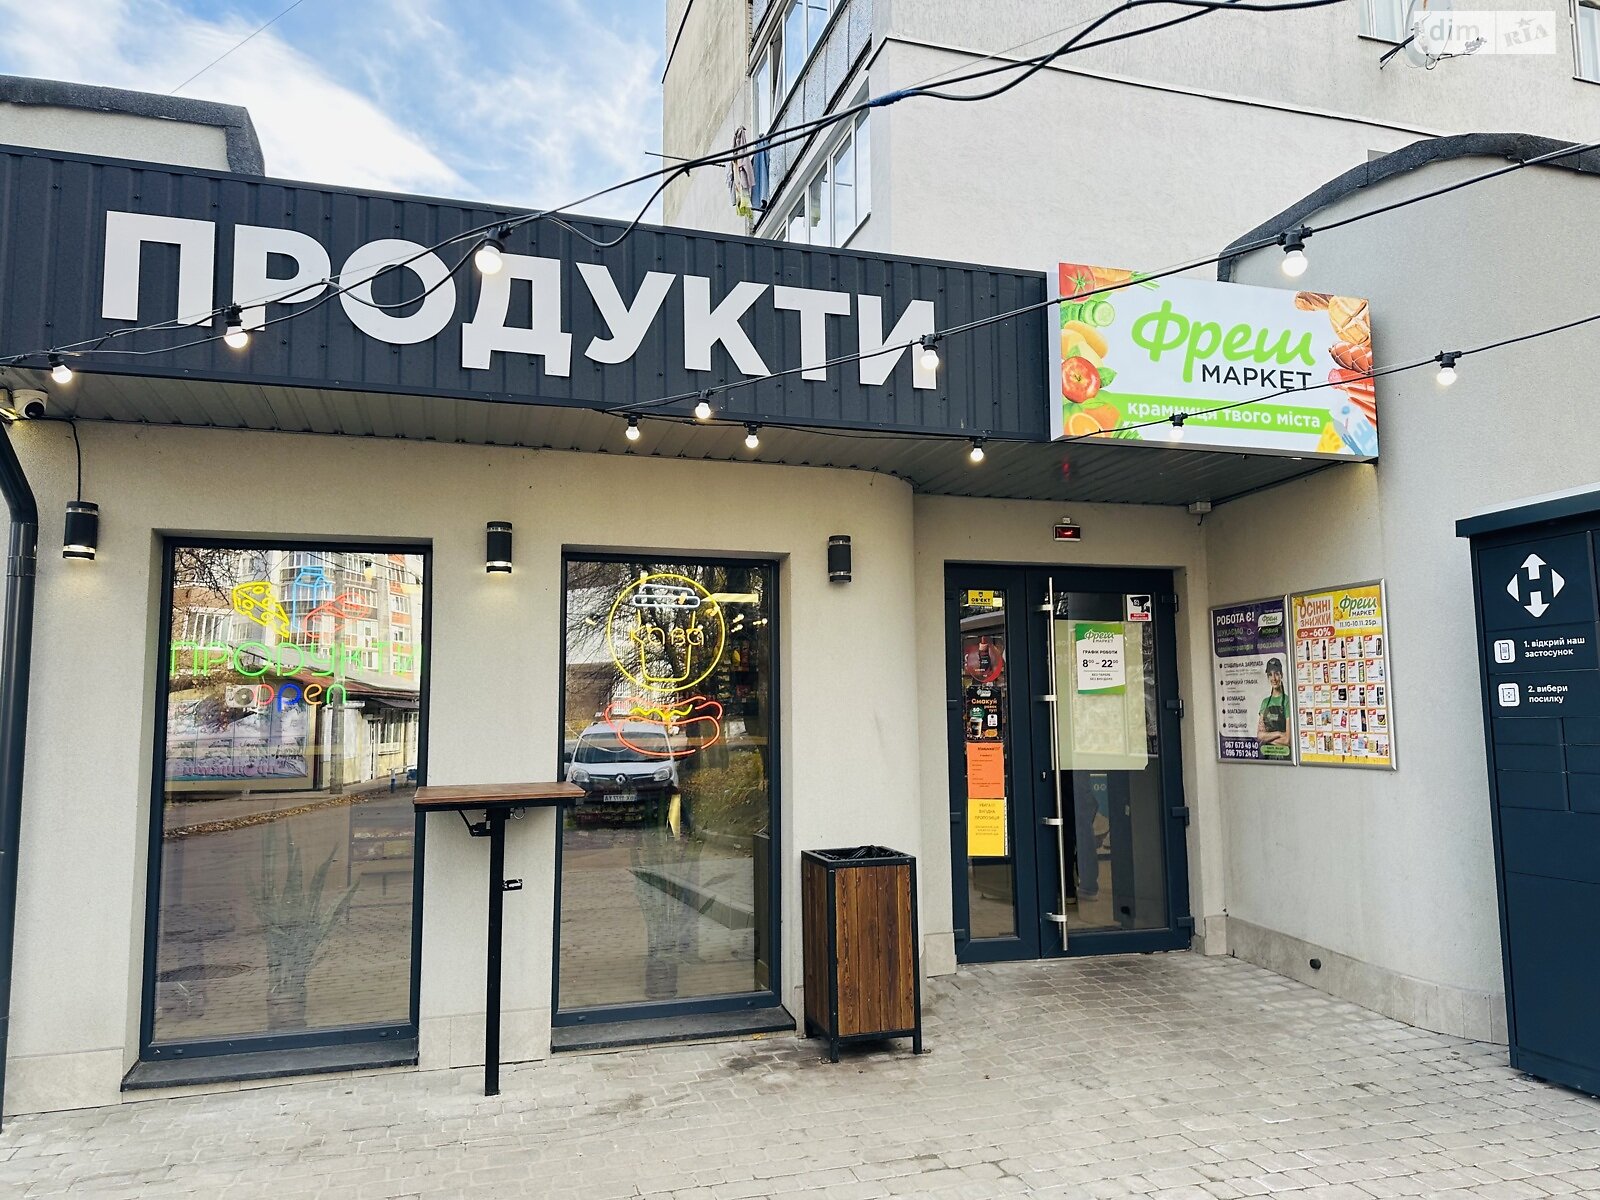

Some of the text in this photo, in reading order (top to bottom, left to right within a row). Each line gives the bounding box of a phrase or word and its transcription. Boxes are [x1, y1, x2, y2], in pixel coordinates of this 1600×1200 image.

[102, 210, 938, 390] ПРОДУКТИ
[1131, 300, 1316, 382] Фреш
[1202, 364, 1312, 391] МАРКЕТ
[1222, 408, 1272, 426] твого
[1276, 410, 1321, 429] міста
[1299, 600, 1331, 619] ОСІННІ
[1339, 594, 1377, 617] Фреш
[1351, 609, 1376, 617] МАРКЕТ
[1216, 611, 1255, 626] РОБОТА Є!
[1300, 612, 1331, 628] ЗНИЖКИ
[1524, 637, 1586, 648] 1. відкрий наш
[1525, 648, 1574, 658] застосунок
[1527, 684, 1569, 694] 2. вибери
[1528, 694, 1565, 704] посилку
